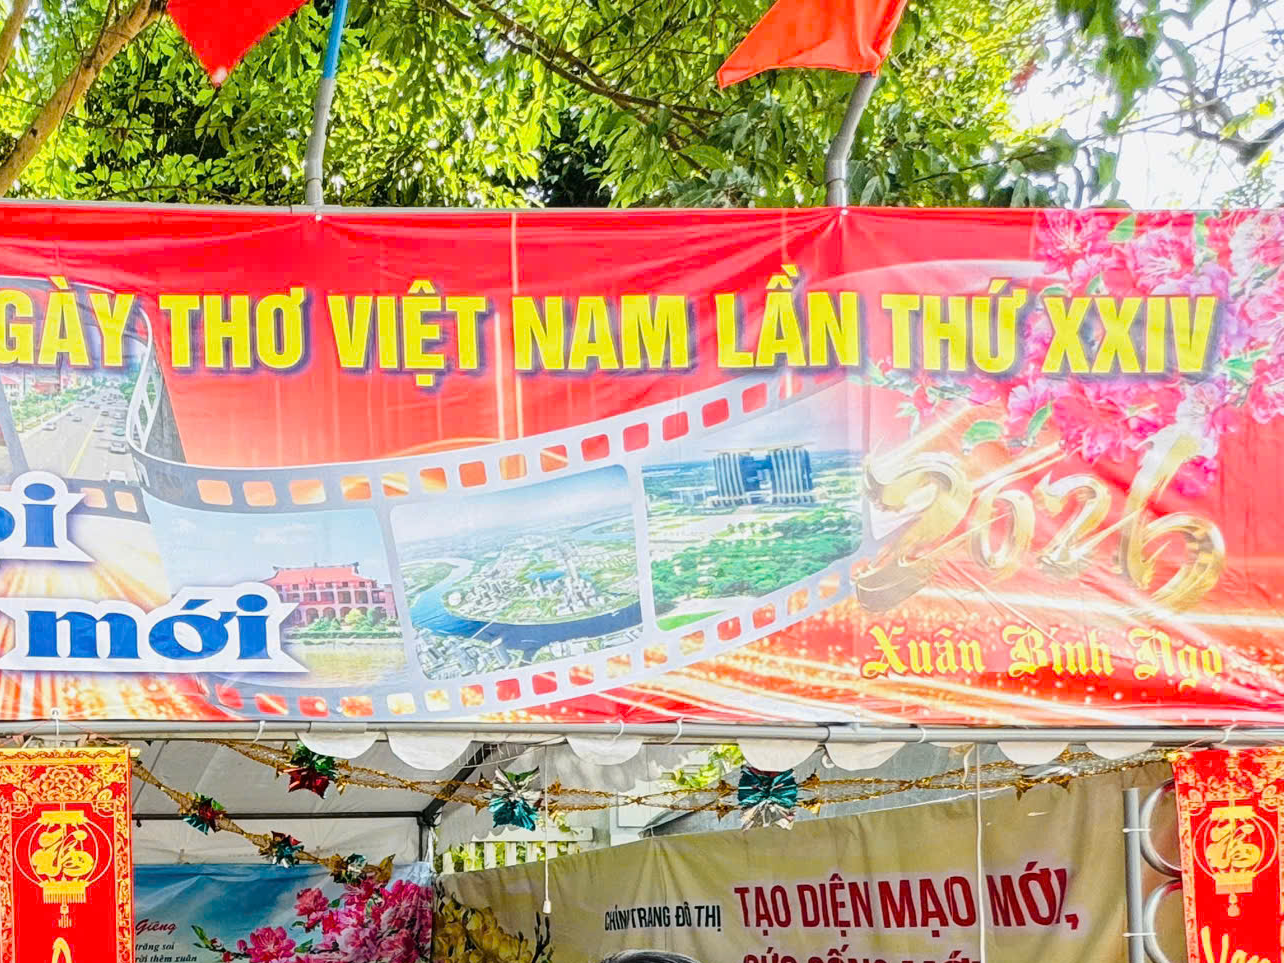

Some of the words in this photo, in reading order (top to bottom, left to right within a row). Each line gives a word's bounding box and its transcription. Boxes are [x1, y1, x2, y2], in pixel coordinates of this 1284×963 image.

[159, 288, 309, 369] THƠ
[327, 279, 487, 386] VIỆT
[515, 294, 689, 371] NAM
[715, 263, 860, 369] LẦN
[883, 279, 1026, 374] THỨ
[1040, 295, 1218, 374] XXIV
[856, 428, 1226, 612] 2026
[26, 590, 273, 661] mới
[862, 625, 985, 678] Xuân
[1128, 627, 1223, 692] Ngọ
[630, 904, 671, 929] TRANG
[674, 902, 692, 928] ĐÔ
[693, 905, 722, 933] THỊ
[734, 884, 792, 937] TẠO
[797, 872, 870, 936] DIỆN
[880, 875, 976, 938] MẠO
[135, 955, 148, 963] rời
[150, 954, 172, 963] thêm
[174, 954, 197, 963] xuân
[162, 941, 175, 951] soi
